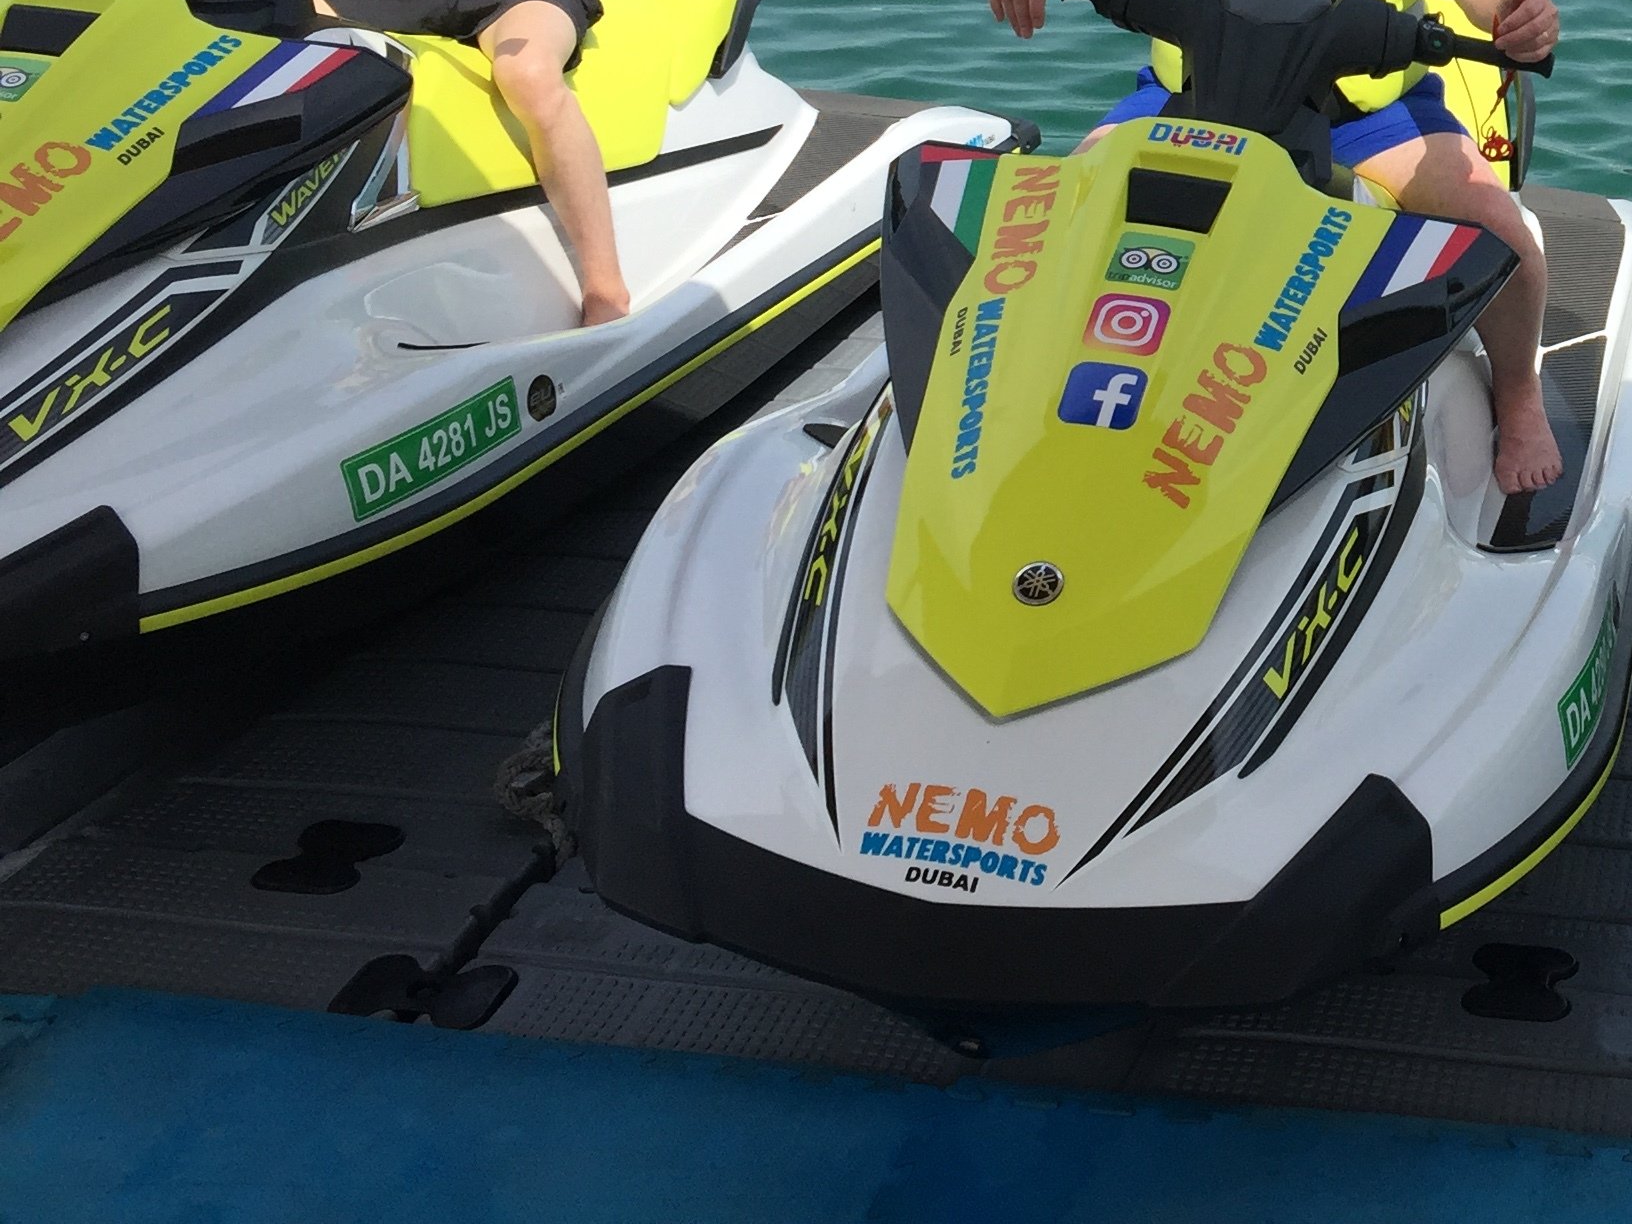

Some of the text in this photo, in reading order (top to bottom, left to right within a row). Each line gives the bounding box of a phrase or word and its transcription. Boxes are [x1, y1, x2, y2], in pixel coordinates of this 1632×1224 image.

[84, 34, 242, 152] WATERSPORTS
[116, 126, 165, 166] DUBAI
[950, 307, 968, 356] DUBAI
[951, 165, 1061, 479] NEMO WATERSPORTS
[1294, 327, 1328, 375] DUBAI
[1142, 206, 1352, 509] NEMO WATERSPORTS
[357, 393, 512, 504] DA 4281 JS
[1566, 687, 1591, 749] DA
[868, 782, 1061, 855] NEMO
[860, 831, 1047, 886] WATERSPORTS
[905, 866, 979, 893] DUBAI
